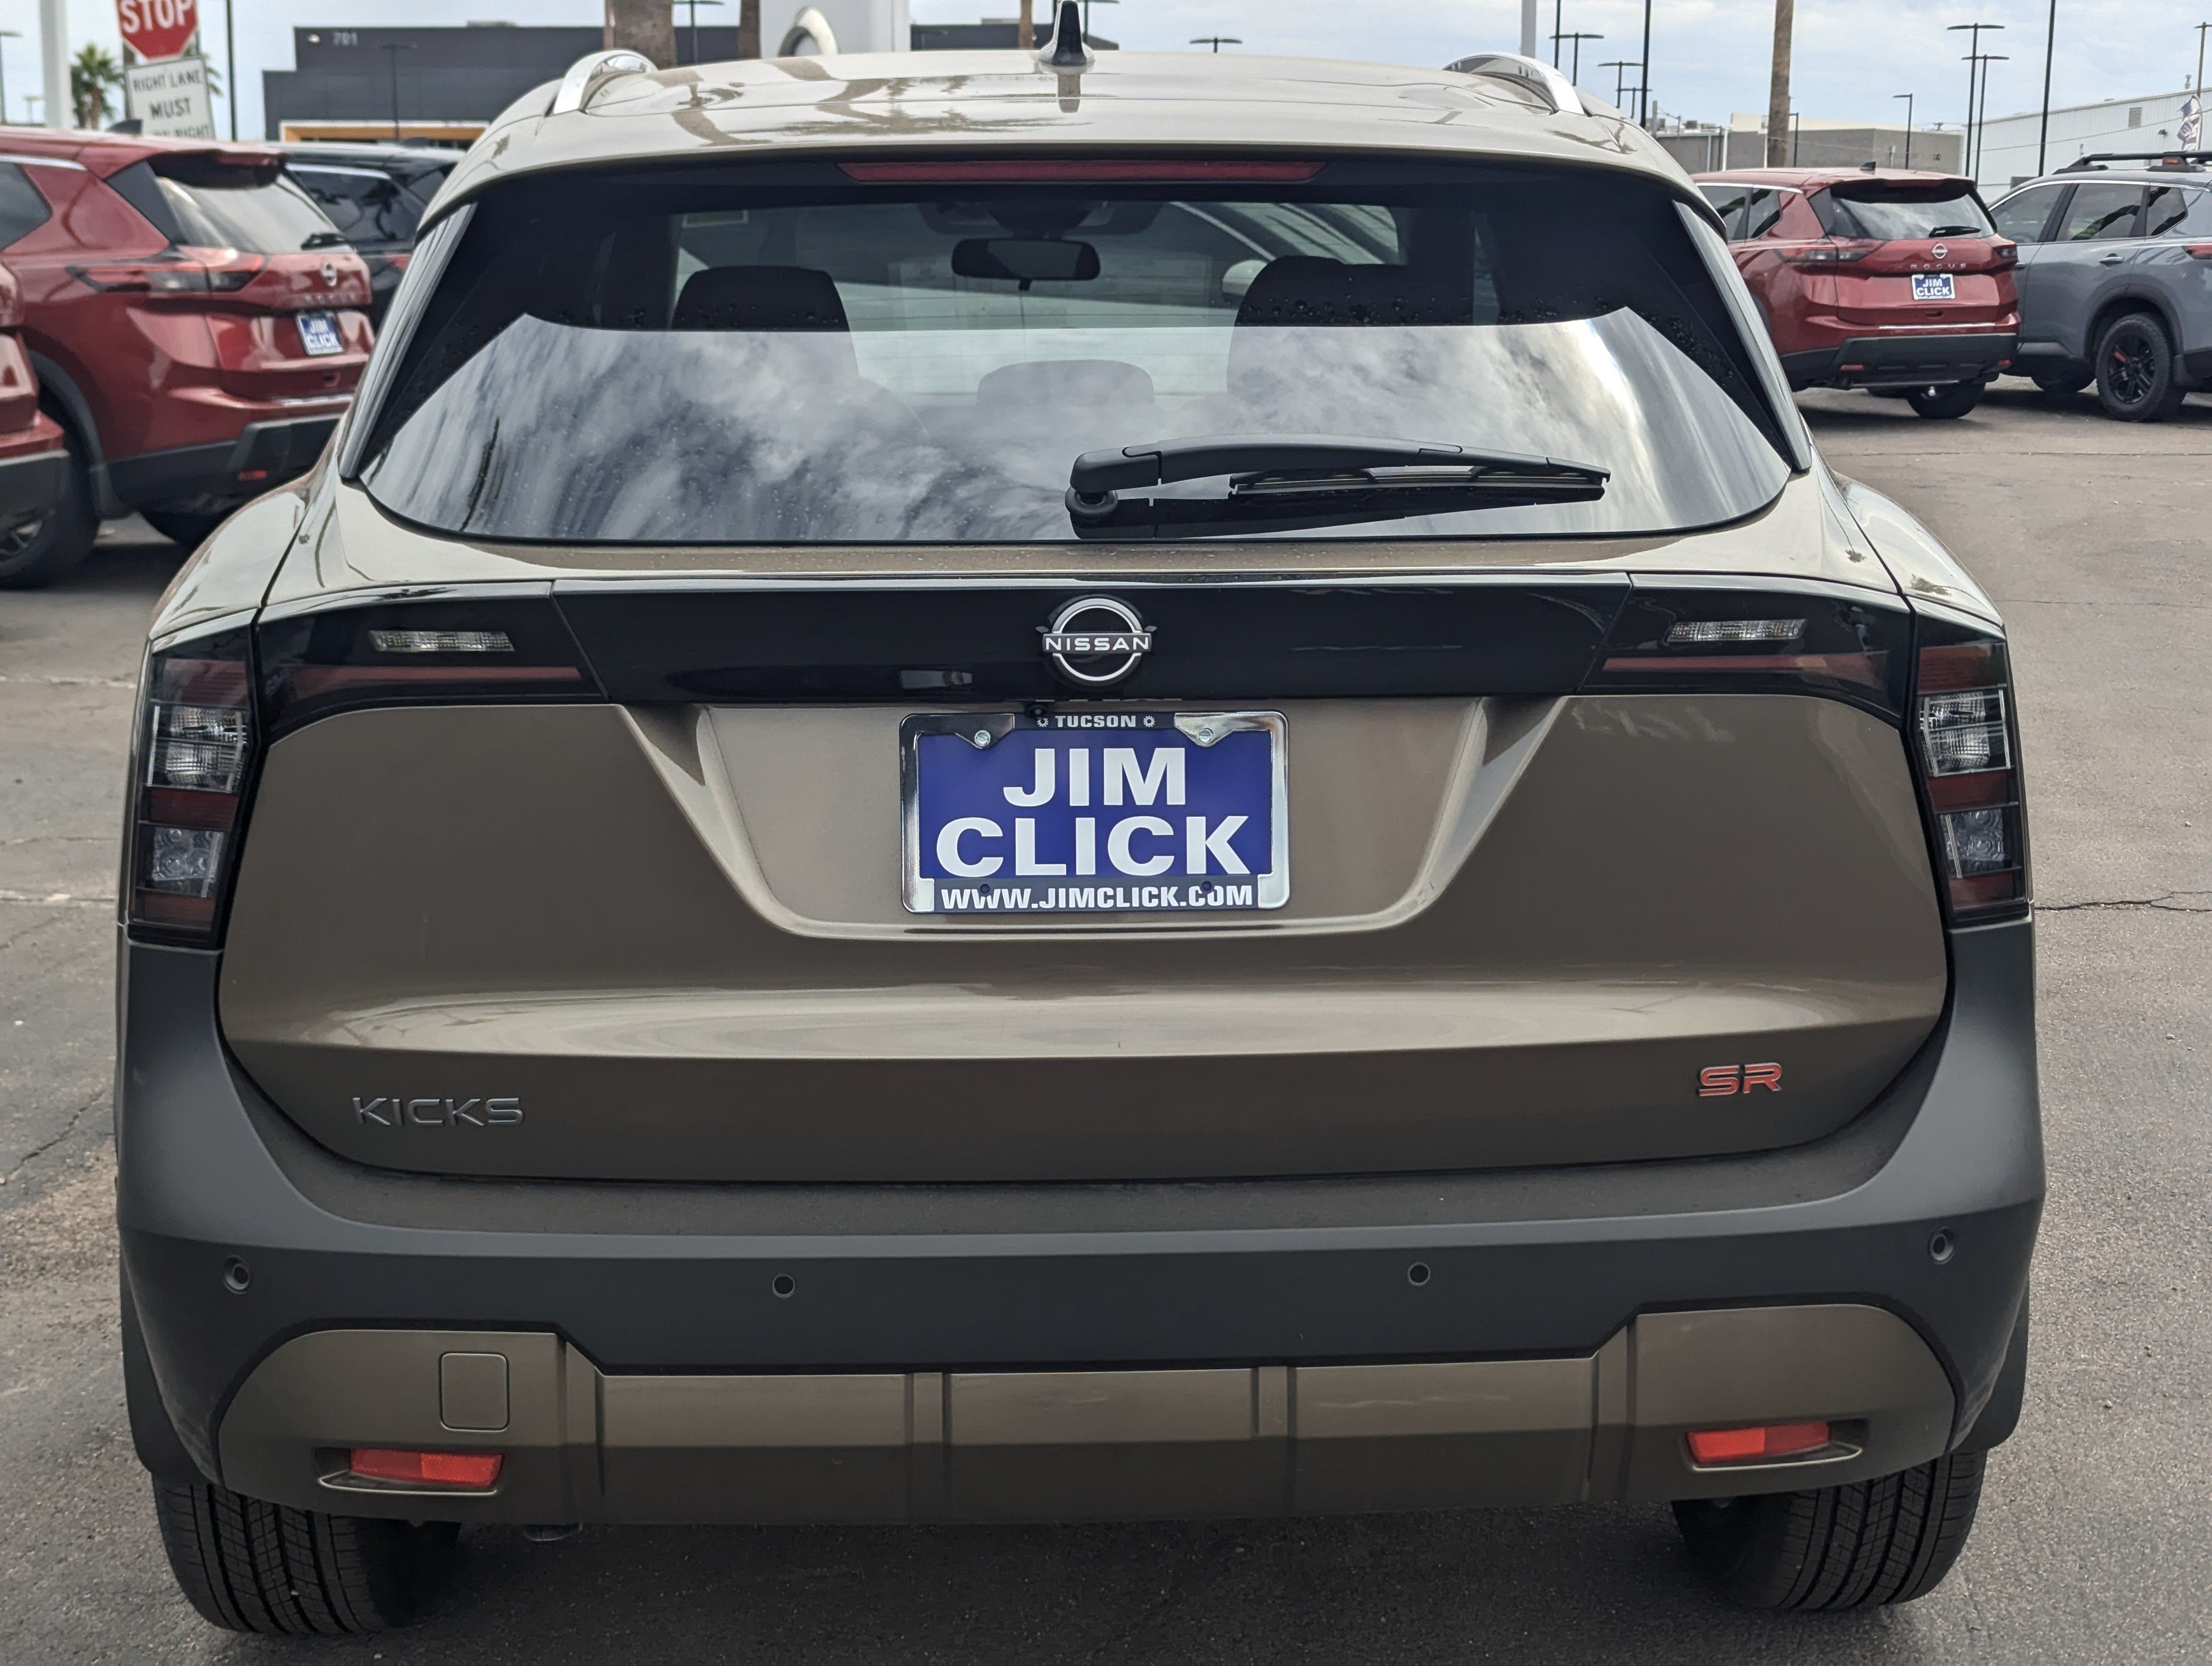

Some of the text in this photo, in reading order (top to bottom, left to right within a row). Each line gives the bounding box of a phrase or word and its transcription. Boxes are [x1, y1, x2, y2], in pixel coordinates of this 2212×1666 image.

[120, 0, 193, 34] STOP
[333, 31, 357, 46] 701
[133, 70, 201, 92] RIGHT LANE
[150, 97, 190, 119] MUST
[1917, 287, 1950, 296] CLICK
[1922, 278, 1943, 287] JIM
[306, 333, 338, 348] CLICK
[1045, 637, 1149, 651] NISSAN
[1055, 715, 1136, 727] TUCSON
[1003, 747, 1186, 806] JIM
[936, 815, 1251, 877] CLICK
[941, 885, 1252, 909] WWW.JIMCLICK.COM
[1699, 1062, 1782, 1097] SR
[353, 1097, 524, 1126] KICKS
